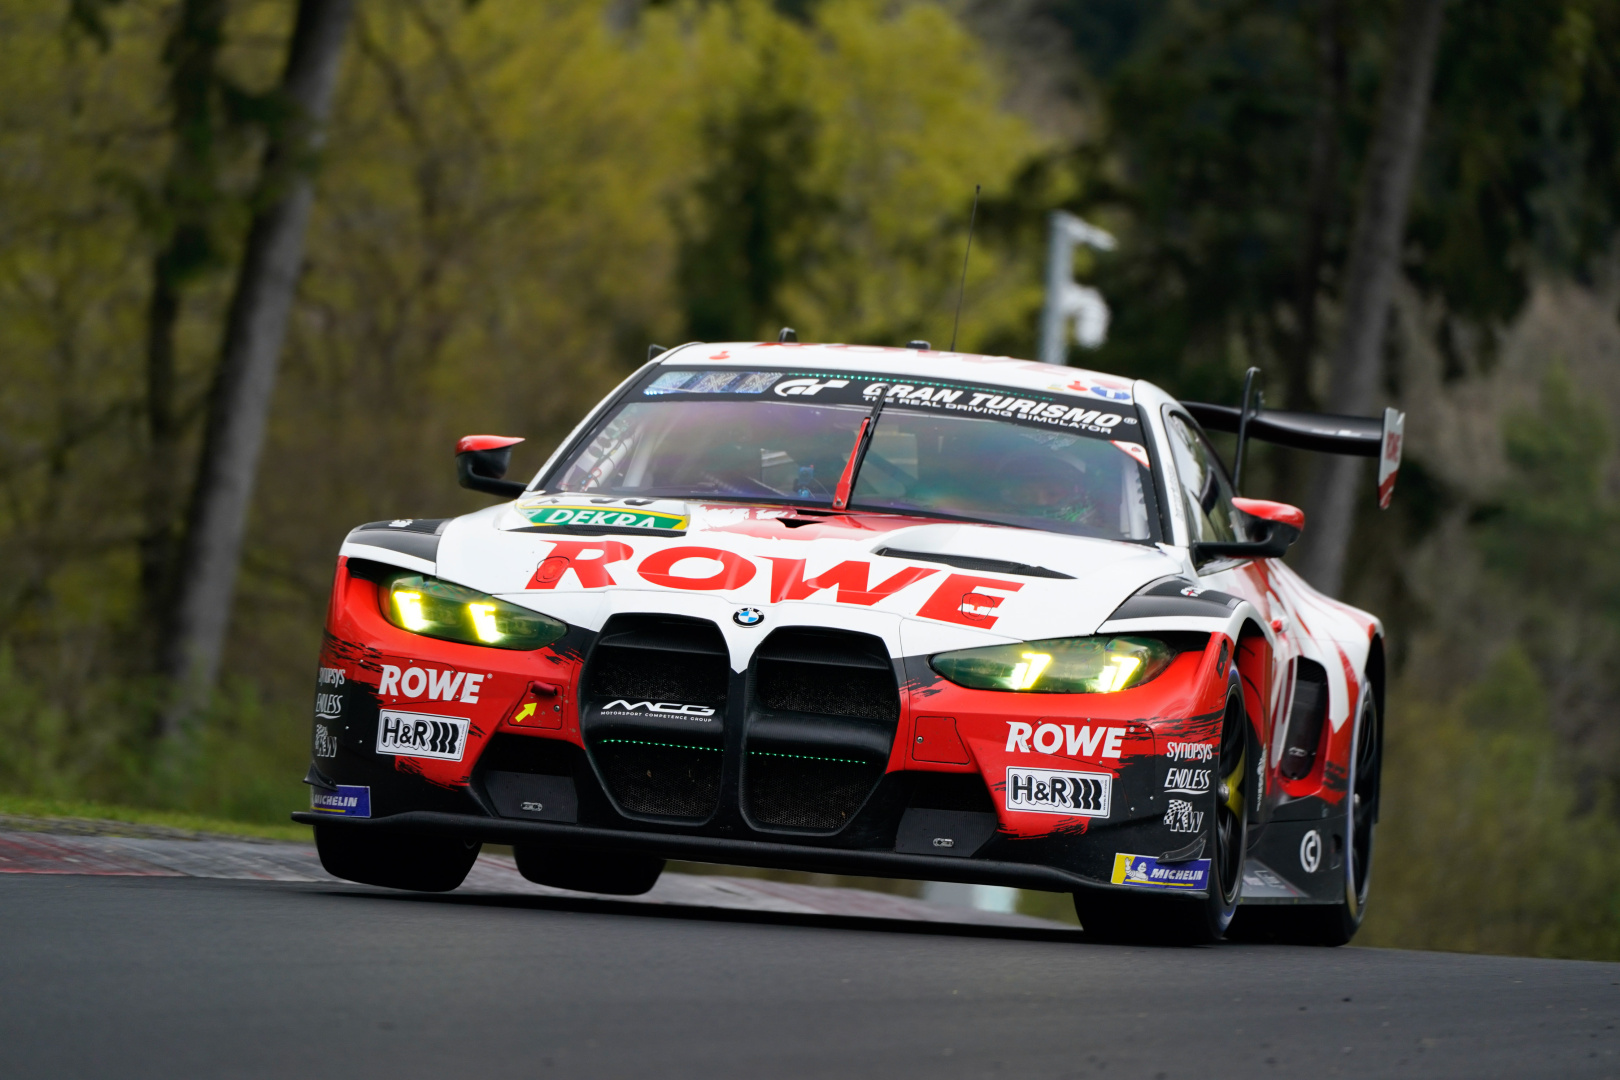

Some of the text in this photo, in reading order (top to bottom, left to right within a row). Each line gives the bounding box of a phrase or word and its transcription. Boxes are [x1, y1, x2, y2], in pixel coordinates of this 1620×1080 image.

[863, 382, 1122, 427] GRAN TURISMO
[899, 398, 941, 408] REAL
[945, 402, 1012, 417] DRIVING
[1017, 412, 1112, 434] SIMULATOR
[545, 509, 656, 528] DEKRA
[524, 540, 1025, 629] ROWE
[378, 664, 485, 704] ROWE
[602, 699, 716, 716] MCG
[644, 712, 688, 720] COMPETENCE
[382, 717, 428, 749] H&R
[1005, 721, 1127, 758] ROWE
[1166, 741, 1213, 763] SYNOPSYS
[1012, 774, 1070, 806] H&R
[1164, 767, 1211, 789] ENDLESS
[1170, 810, 1204, 833] KW
[1150, 868, 1204, 881] MICHELIN
